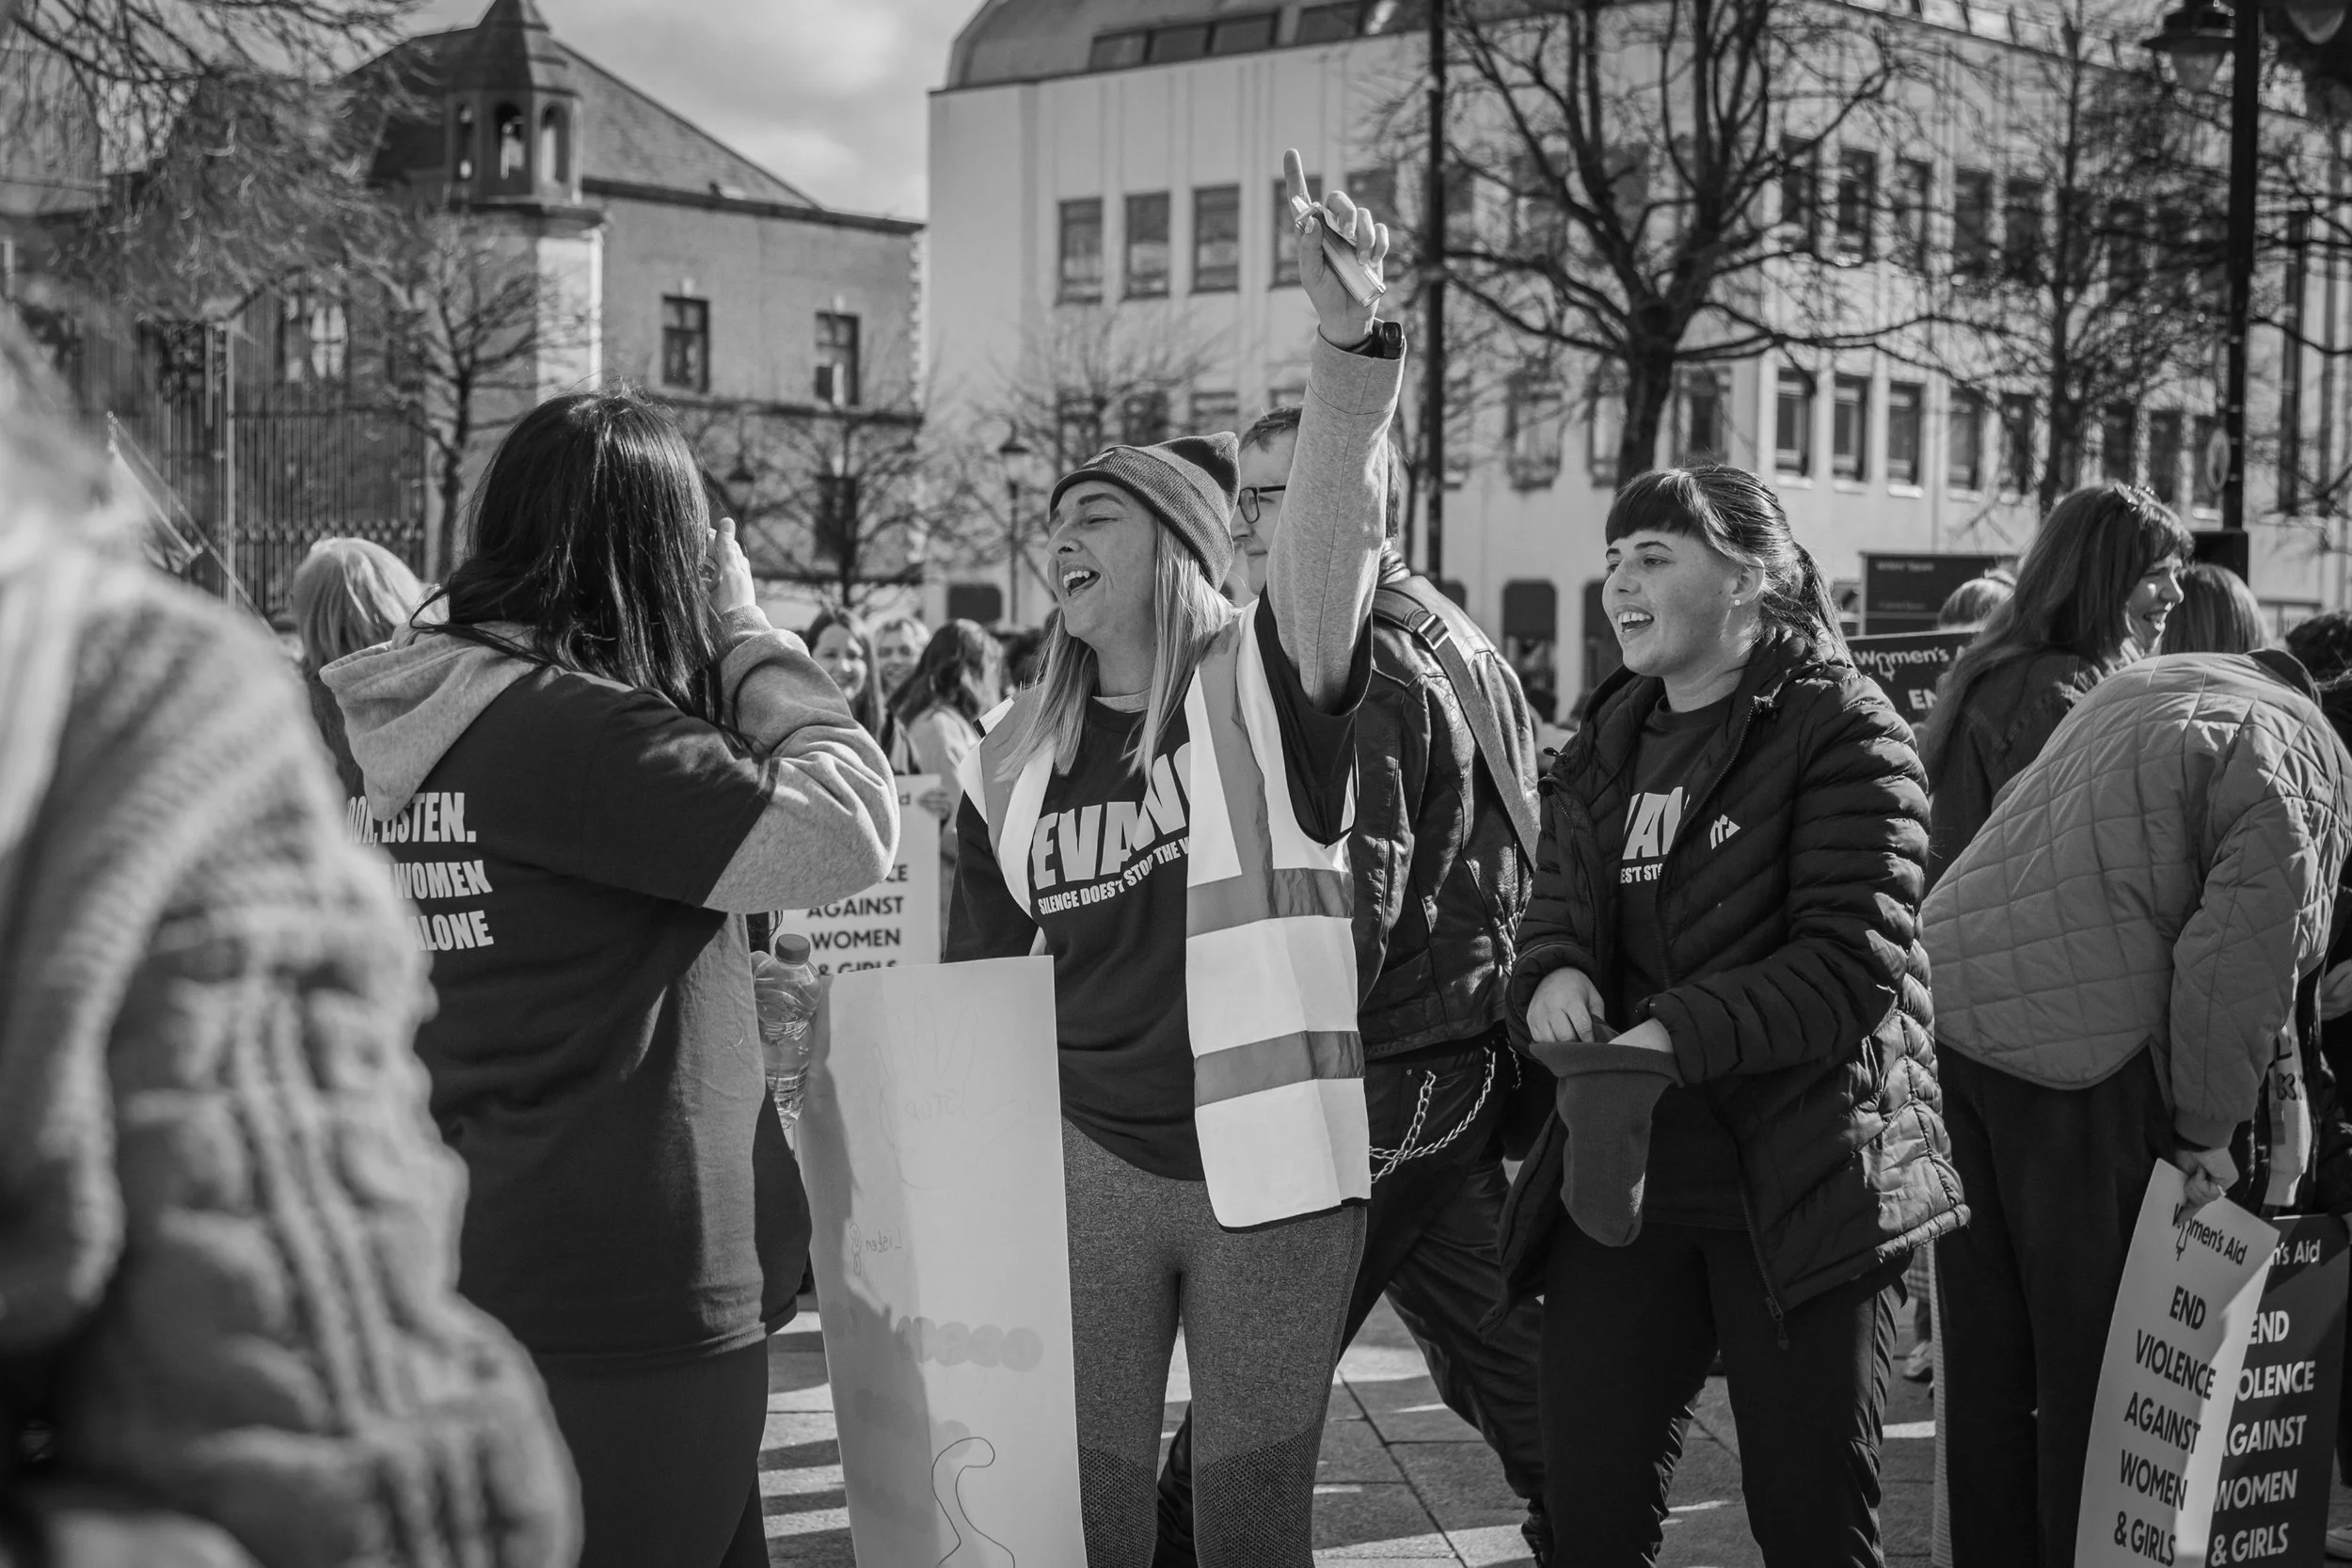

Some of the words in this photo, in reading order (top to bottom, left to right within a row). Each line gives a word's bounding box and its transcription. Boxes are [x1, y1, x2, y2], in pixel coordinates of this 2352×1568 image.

[1908, 689, 1938, 709] EN
[393, 860, 493, 899] WOMEN
[1038, 890, 1079, 914] SILENCE
[1152, 841, 1181, 864] THE
[806, 896, 904, 918] AGAINST
[810, 927, 901, 950] WOMEN
[2223, 1237, 2249, 1266] Aid
[2293, 1239, 2321, 1264] Aid
[2169, 1285, 2206, 1330] END
[2136, 1329, 2217, 1401] VIOLENCE
[2236, 1361, 2316, 1402] OLENCE
[2123, 1391, 2201, 1454] AGAINST
[2120, 1449, 2187, 1511] WOMEN
[2214, 1468, 2297, 1512] WOMEN
[2114, 1511, 2126, 1547] &
[2131, 1518, 2176, 1567] GIRLS
[2211, 1534, 2227, 1567] &
[2232, 1522, 2289, 1562] GIRLS
